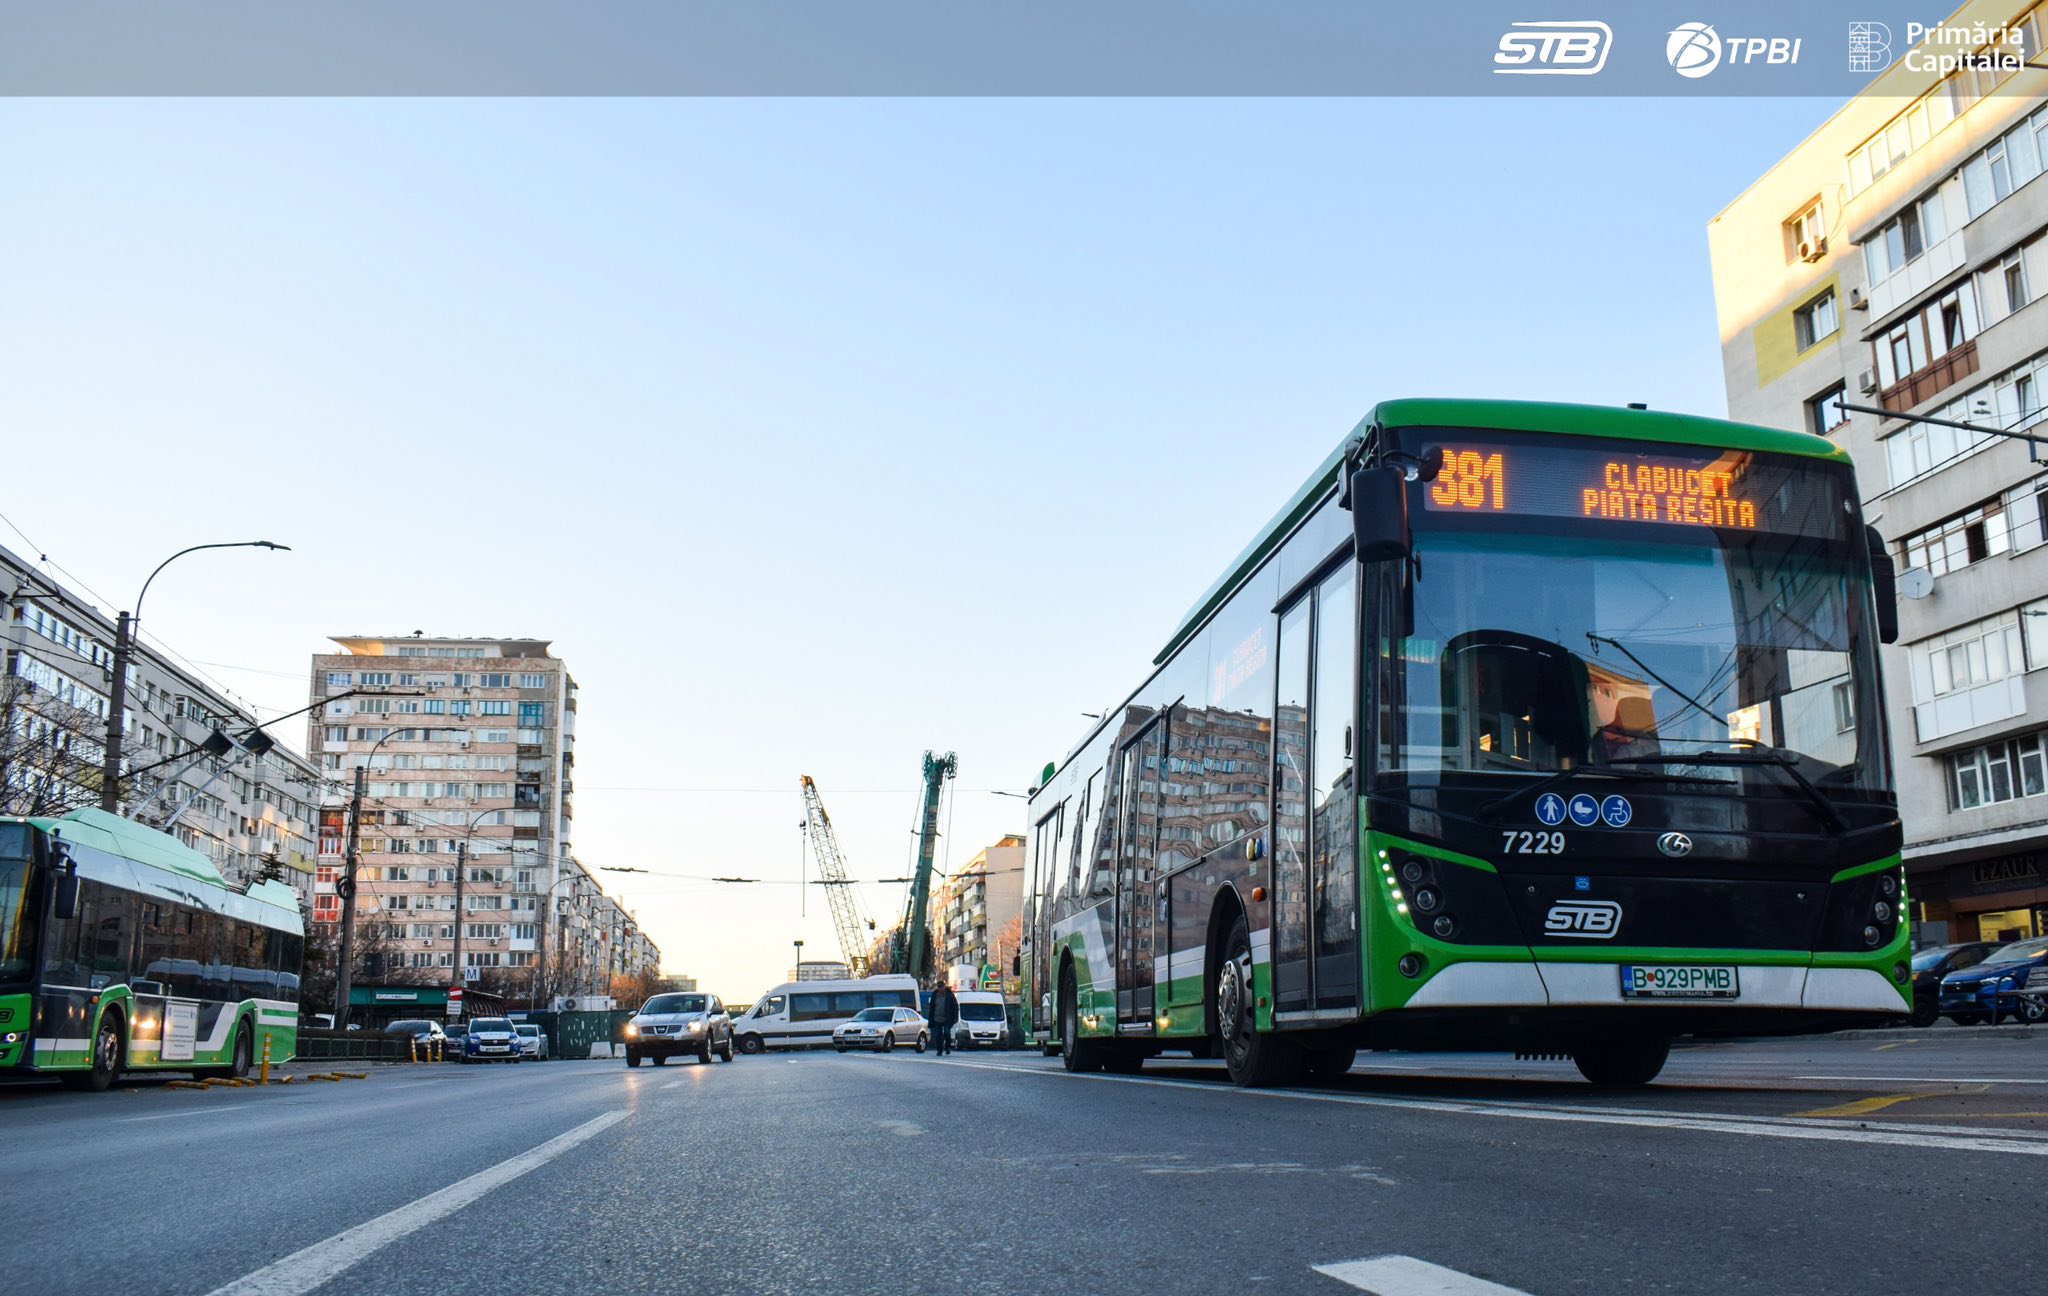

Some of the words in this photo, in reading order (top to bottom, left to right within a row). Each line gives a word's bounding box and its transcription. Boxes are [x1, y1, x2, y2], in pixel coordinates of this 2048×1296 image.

[1432, 449, 1504, 510] 381
[1604, 462, 1732, 498] CLABUCET
[1583, 488, 1658, 521] PIATA
[1666, 495, 1756, 528] RESITA
[1502, 831, 1566, 855] 7229
[1969, 856, 2039, 881] TEZAUR
[1544, 906, 1615, 931] STB
[466, 968, 477, 980] M
